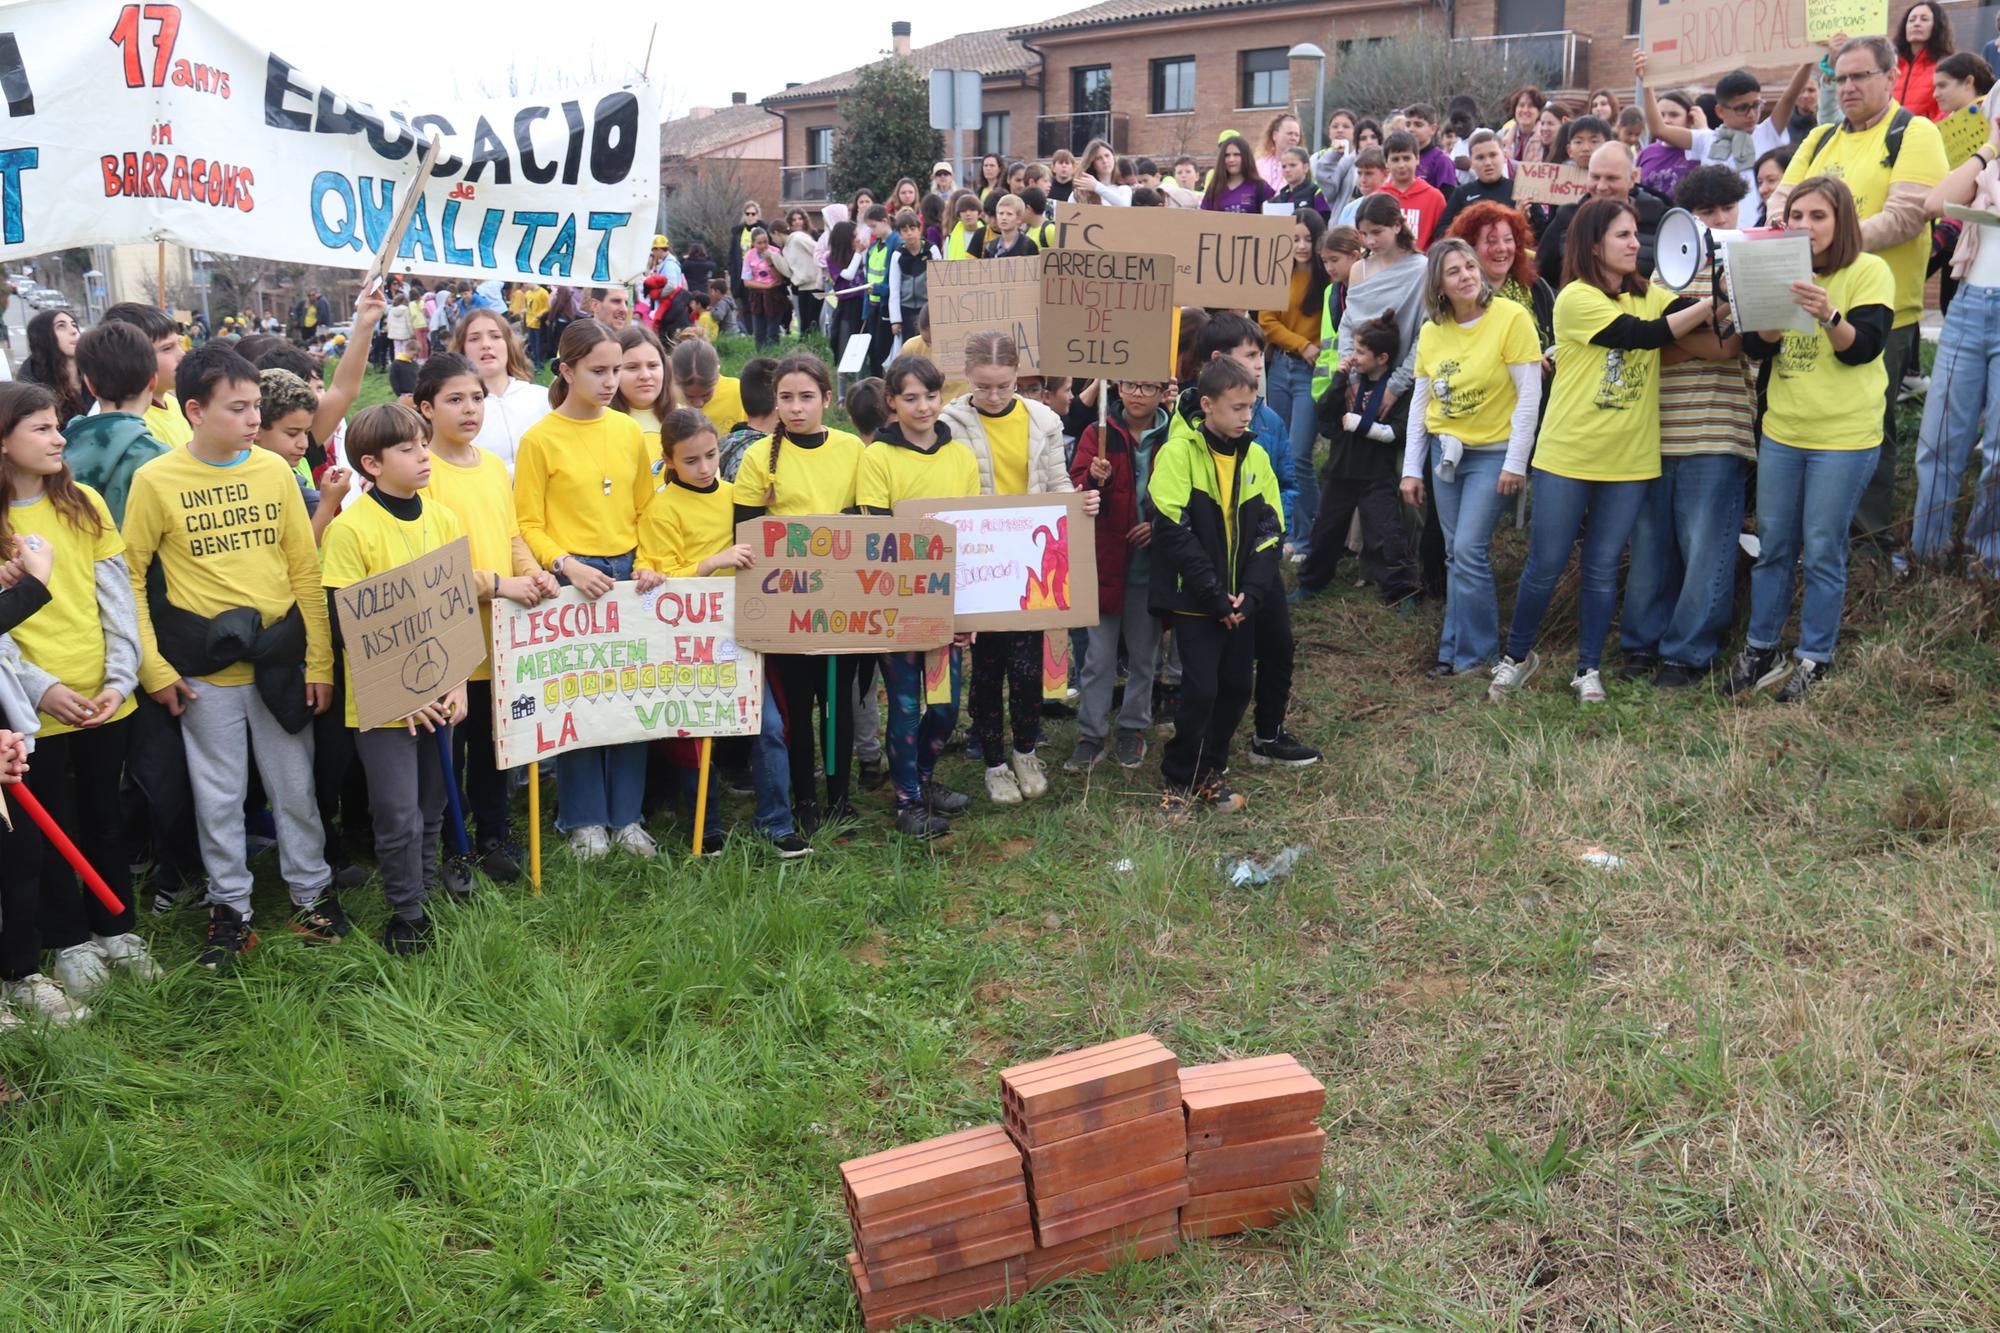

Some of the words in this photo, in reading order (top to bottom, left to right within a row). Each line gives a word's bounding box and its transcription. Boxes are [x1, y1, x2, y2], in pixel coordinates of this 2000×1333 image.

[109, 4, 182, 88] 17
[448, 182, 476, 200] de
[310, 170, 633, 282] QUALITAT
[929, 259, 992, 287] VOLEM
[998, 258, 1017, 283] UN
[1043, 252, 1155, 281] ARREGLEM
[1196, 232, 1294, 286] FUTUR
[932, 288, 1016, 325] INSTITUT
[1045, 277, 1172, 312] L'INSTITUT
[1084, 307, 1113, 333] DE
[1067, 339, 1129, 365] SILS
[180, 483, 249, 510] UNITED
[185, 505, 261, 533] COLORS
[190, 527, 280, 557] BENETTO
[762, 520, 852, 561] PROU
[866, 532, 953, 563] BARRA-
[343, 576, 416, 620] VOLEM
[424, 555, 454, 589] UN
[761, 568, 825, 594] CONS
[856, 569, 951, 597] VOLEM
[361, 606, 433, 660] INSTITUT
[440, 573, 474, 621] JA!
[655, 591, 725, 628] QUE
[788, 608, 899, 638] MAONS!
[516, 638, 648, 684] MEREIXEM
[673, 636, 715, 664] EN
[544, 661, 737, 706] CONDICIONS
[536, 711, 579, 754] LA
[634, 695, 749, 730] VOLEM!
